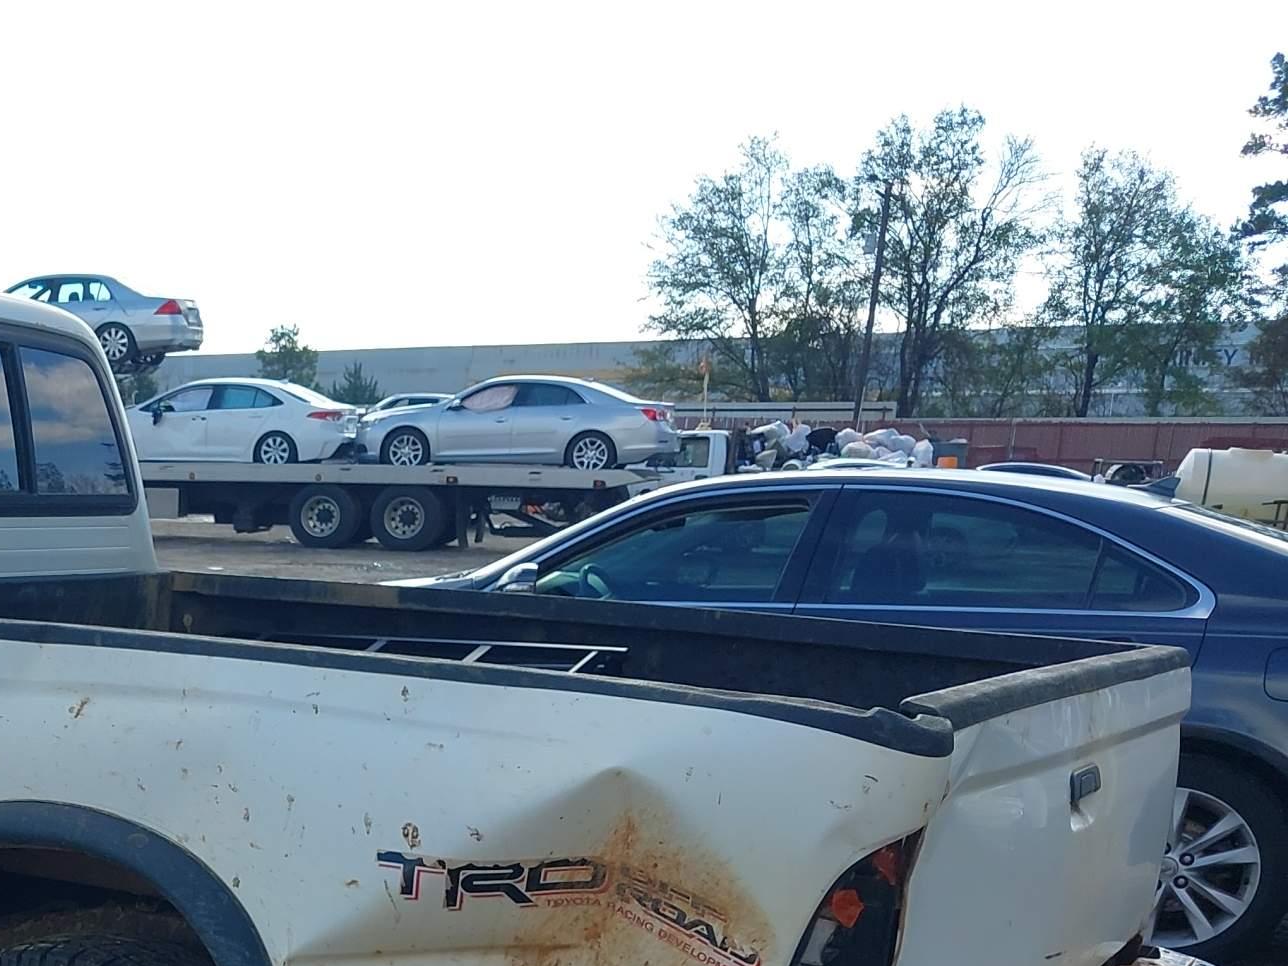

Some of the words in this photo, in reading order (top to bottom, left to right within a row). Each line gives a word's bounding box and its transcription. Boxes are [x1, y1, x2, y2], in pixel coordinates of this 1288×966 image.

[376, 850, 610, 911] TRD
[546, 897, 601, 908] TOYOTA
[607, 901, 655, 933] RACING
